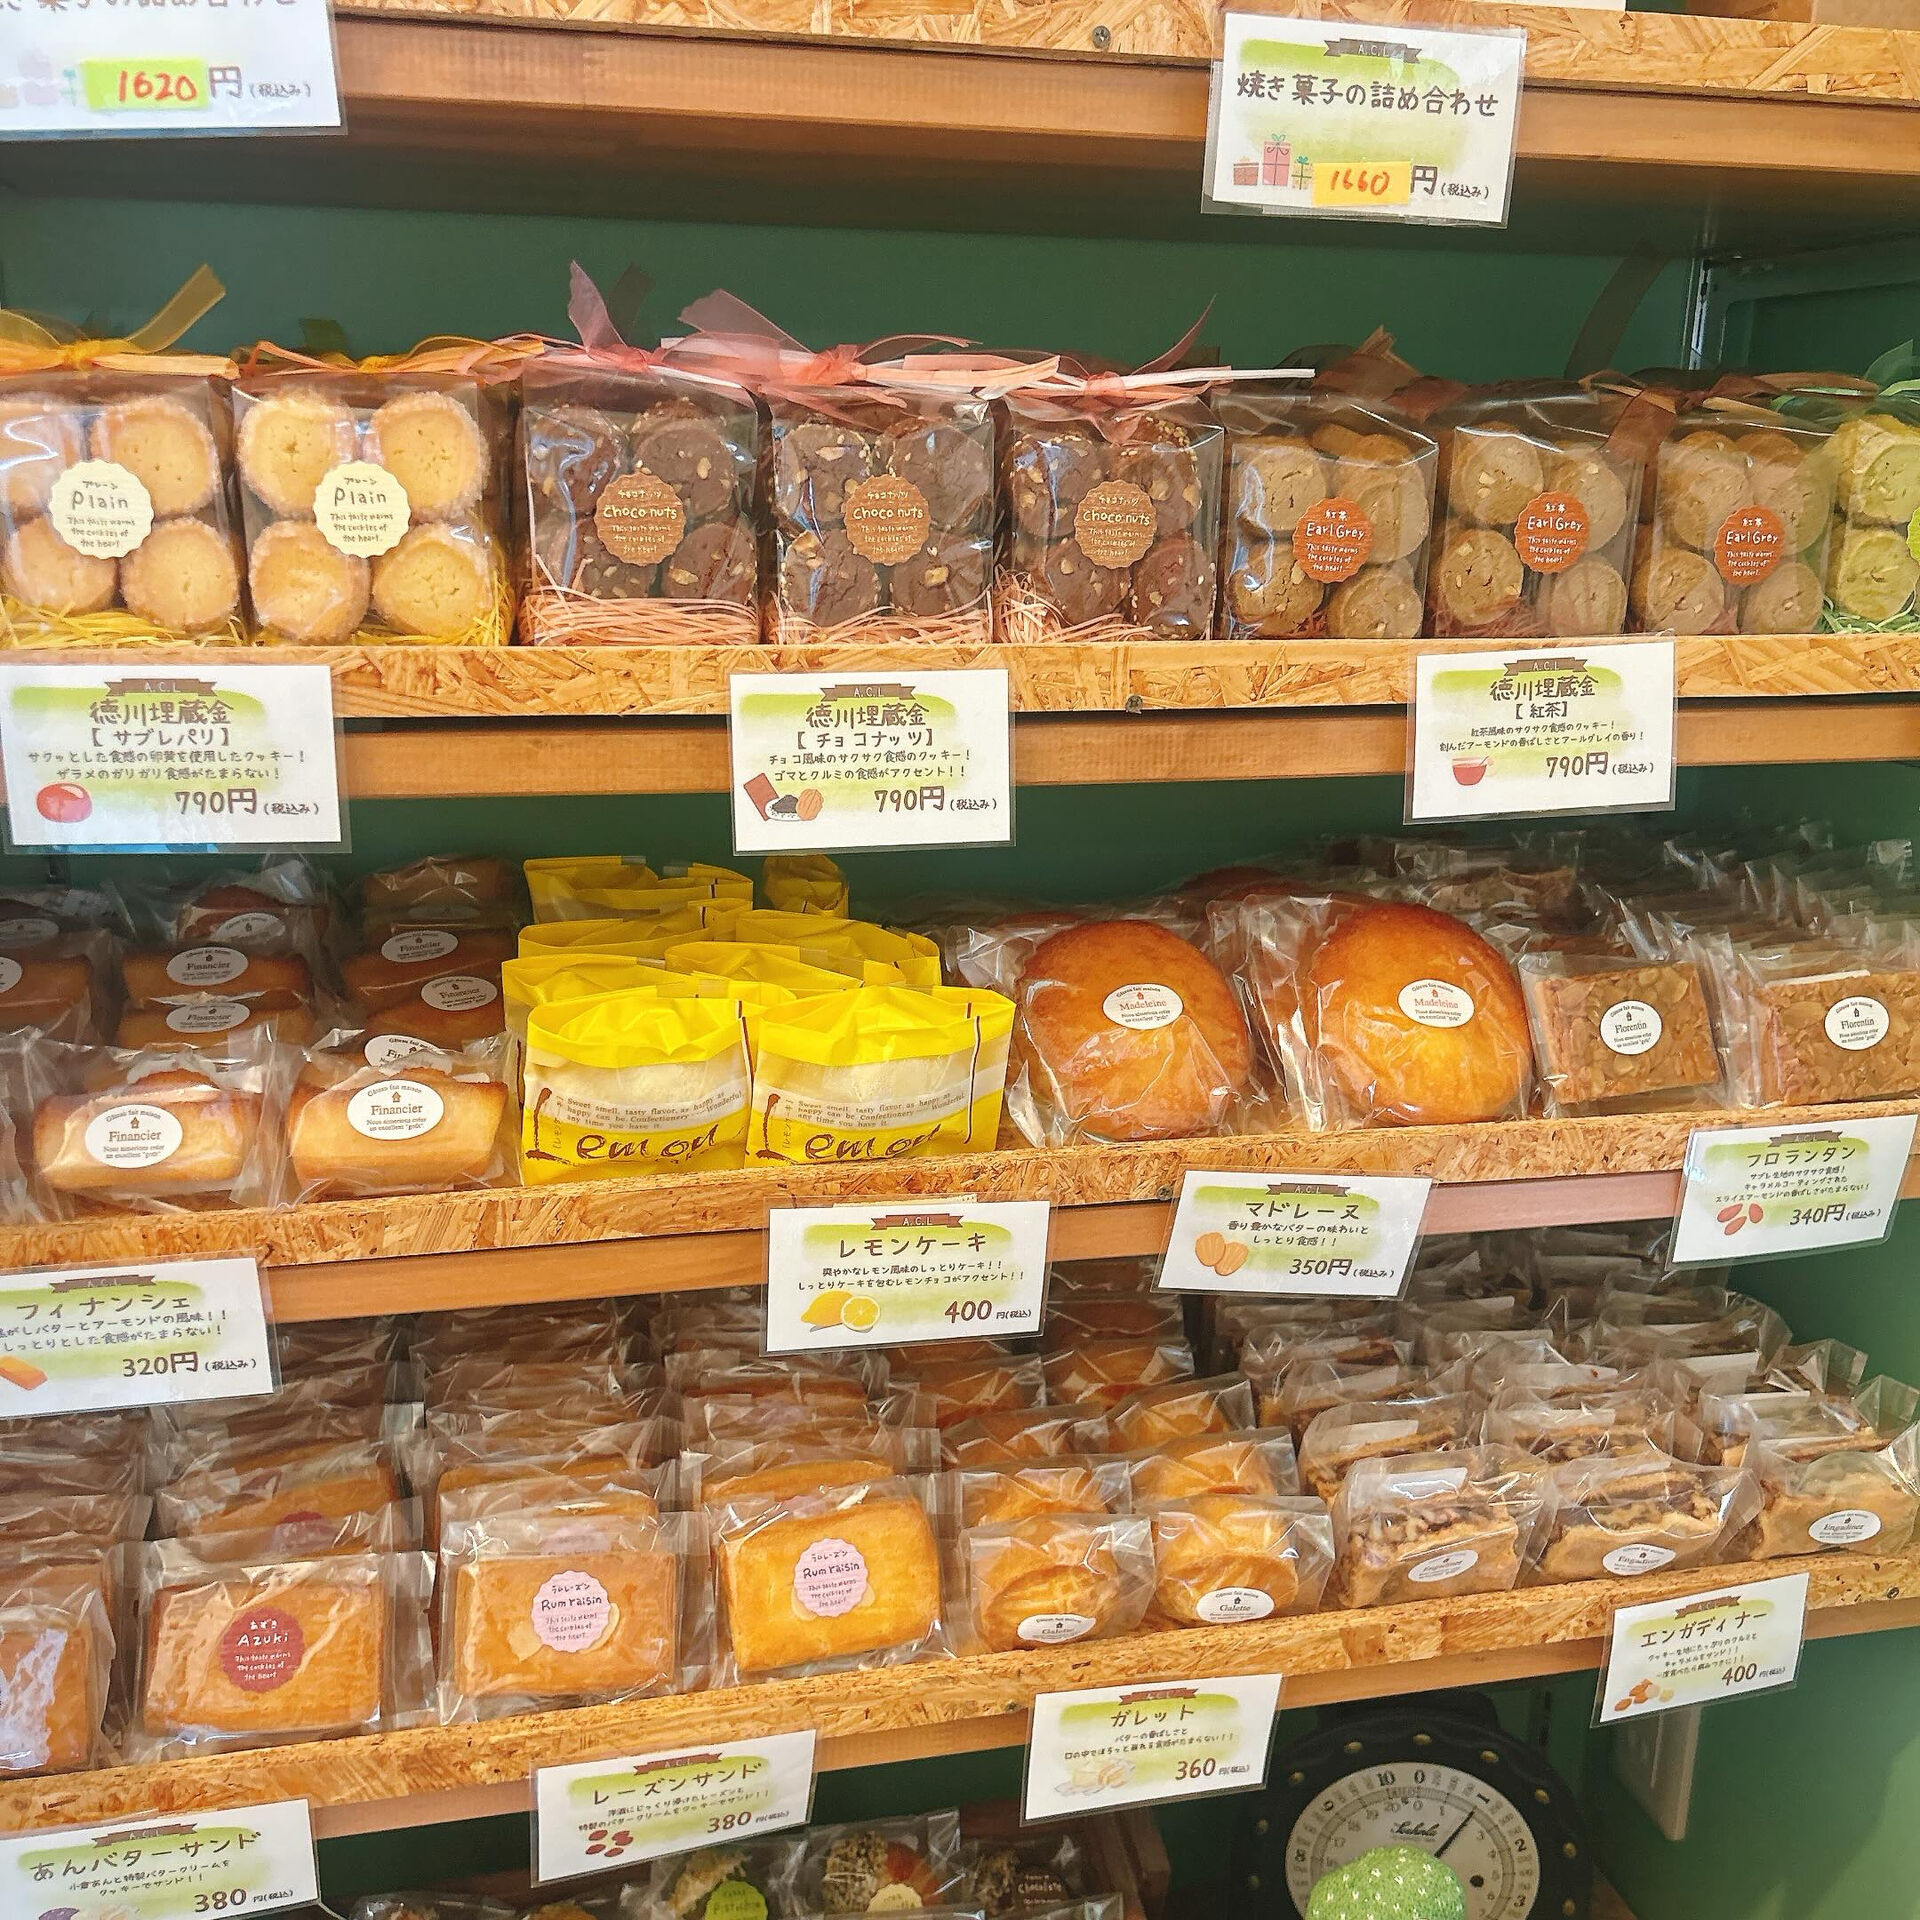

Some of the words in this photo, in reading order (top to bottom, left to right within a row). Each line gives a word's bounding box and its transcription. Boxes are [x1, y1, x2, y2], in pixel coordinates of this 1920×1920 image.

[118, 70, 198, 102] 1620
[208, 65, 242, 98] 円
[1236, 69, 1499, 117] 焼き菓子の詰め合わせ
[1330, 167, 1390, 196] 1660
[1410, 165, 1438, 195] 円
[72, 490, 128, 510] Plain
[334, 487, 387, 506] Plain
[650, 506, 677, 520] nuts
[897, 506, 924, 519] nuts
[1125, 513, 1150, 526] nuts
[1306, 522, 1333, 537] Earl
[1336, 525, 1365, 540] Grey
[1527, 516, 1553, 530] Earl
[1555, 517, 1582, 532] Grey
[1726, 530, 1750, 545] Earl
[1752, 531, 1778, 545] Grey
[853, 686, 885, 698] A.C.L
[1490, 674, 1598, 702] 徳川埋蔵金
[89, 699, 234, 725] 徳川埋蔵金
[806, 703, 930, 729] 徳川埋蔵金
[1514, 700, 1568, 719] 【紅茶】
[1546, 751, 1609, 778] 790円
[175, 788, 257, 815] 790円
[874, 786, 944, 813] 790円
[1119, 1000, 1167, 1011] Madeleine
[1414, 998, 1459, 1009] Madeleine
[1615, 1020, 1647, 1033] Florentin
[1841, 1017, 1875, 1030] Florentin
[370, 1103, 423, 1115] Financier
[109, 1130, 161, 1142] Financier
[1747, 1146, 1856, 1168] フロランタン
[1245, 1200, 1360, 1220] マドレーヌ
[1790, 1203, 1846, 1226] 340円
[902, 1216, 934, 1226] A.C.L
[1227, 1220, 1369, 1235] 香り豊かなバターの味わいと
[839, 1232, 987, 1258] レモンケーキ
[1289, 1258, 1352, 1277] 350円
[16, 1294, 190, 1320] フィナンシェ
[944, 1300, 993, 1323] 400
[123, 1351, 198, 1377] 320円
[803, 1567, 827, 1579] Rum
[829, 1562, 860, 1574] raisin
[551, 1583, 590, 1594] ラムレーズン
[541, 1599, 566, 1612] Rum
[569, 1596, 602, 1606] raisin
[1641, 1611, 1768, 1647] エンガディナー
[237, 1633, 288, 1647] Azuki
[1721, 1663, 1757, 1686] 400
[1111, 1704, 1194, 1728] ガレット
[1175, 1758, 1216, 1780] 360
[1377, 1770, 1395, 1786] 10
[1414, 1769, 1425, 1784] 0
[594, 1763, 762, 1806] レーズンサンド
[707, 1811, 752, 1834] 380
[1514, 1838, 1527, 1851] 2
[29, 1830, 263, 1882] あんバターサンド
[193, 1888, 247, 1913] 380
